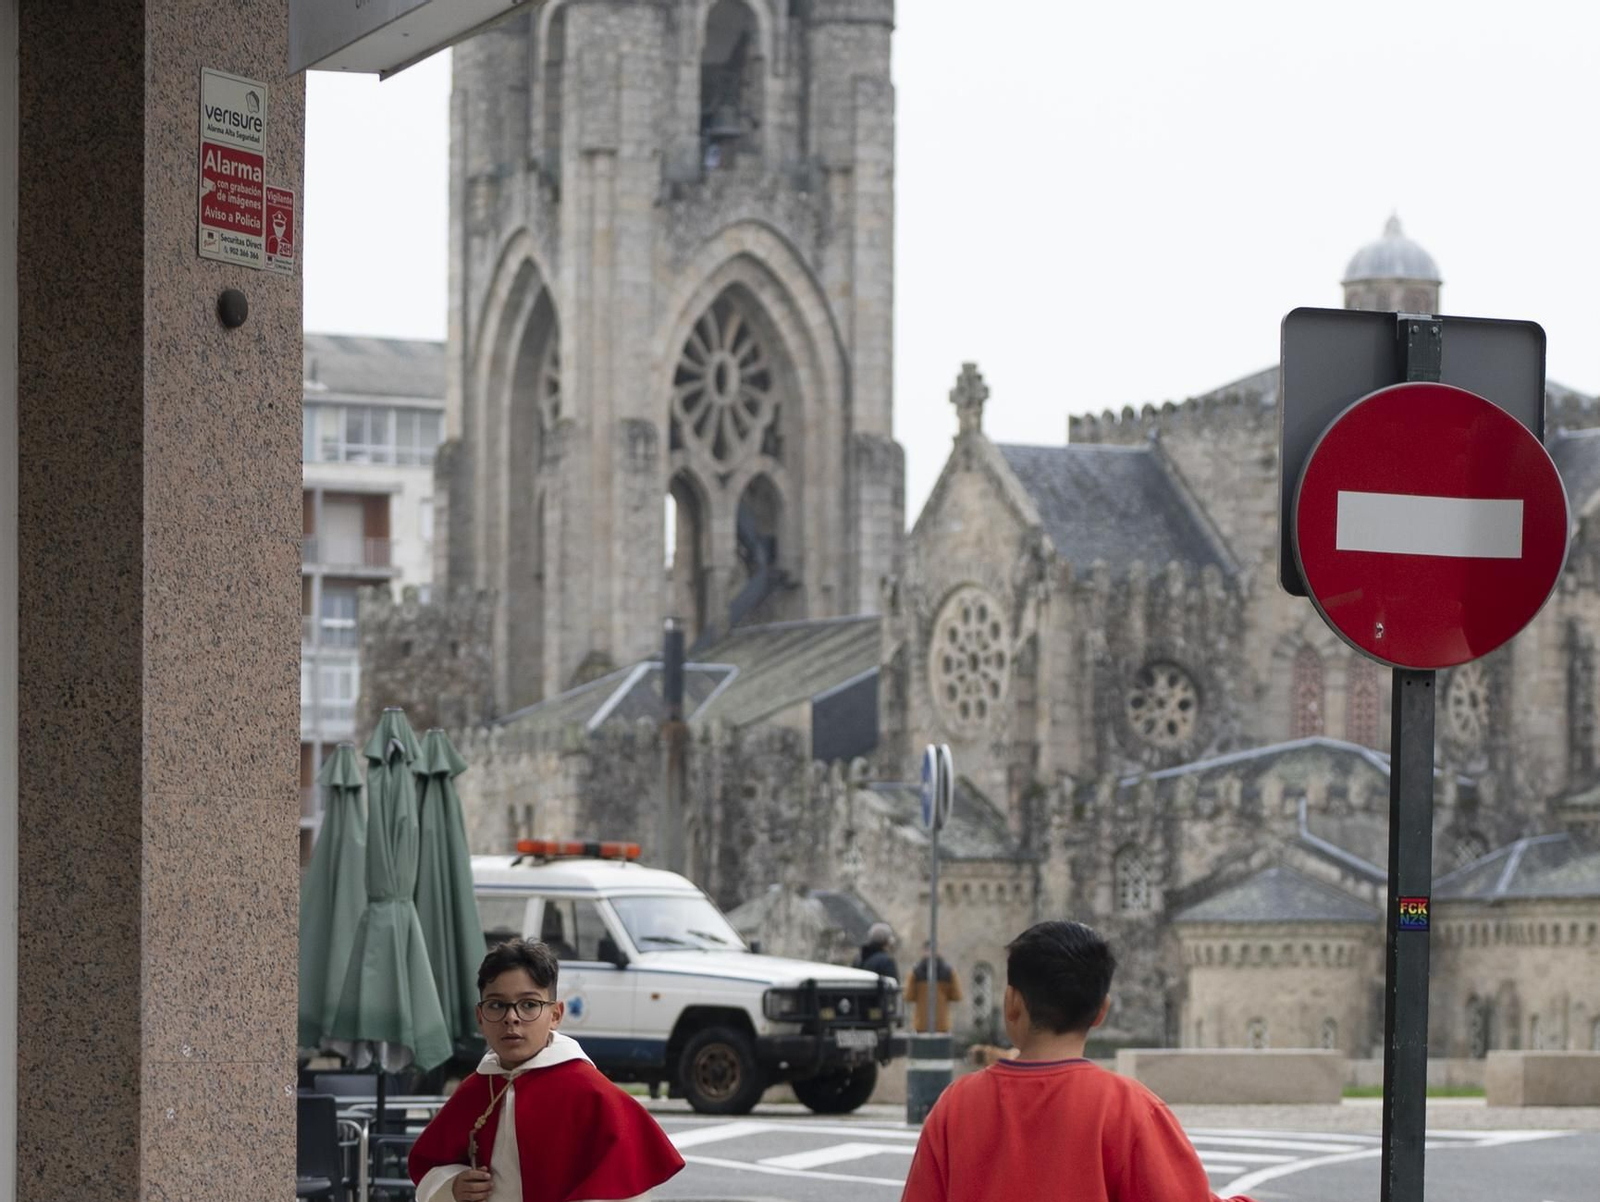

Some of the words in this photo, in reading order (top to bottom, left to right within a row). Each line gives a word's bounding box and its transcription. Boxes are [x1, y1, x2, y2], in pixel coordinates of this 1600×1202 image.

[205, 104, 262, 133] verisure
[207, 123, 224, 134] Alarma
[225, 127, 235, 137] Alta
[236, 130, 261, 144] Seguridad
[203, 149, 262, 183] Alarma
[216, 180, 228, 189] con
[229, 182, 262, 197] grabación
[216, 189, 226, 202] de
[227, 191, 261, 210] imágenes
[266, 190, 293, 206] Vigilante
[204, 205, 227, 221] Aviso
[228, 213, 234, 223] a
[220, 233, 245, 247] Securitas
[245, 238, 262, 250] Direct
[1400, 902, 1428, 914] FCK
[1400, 914, 1428, 926] NZS
